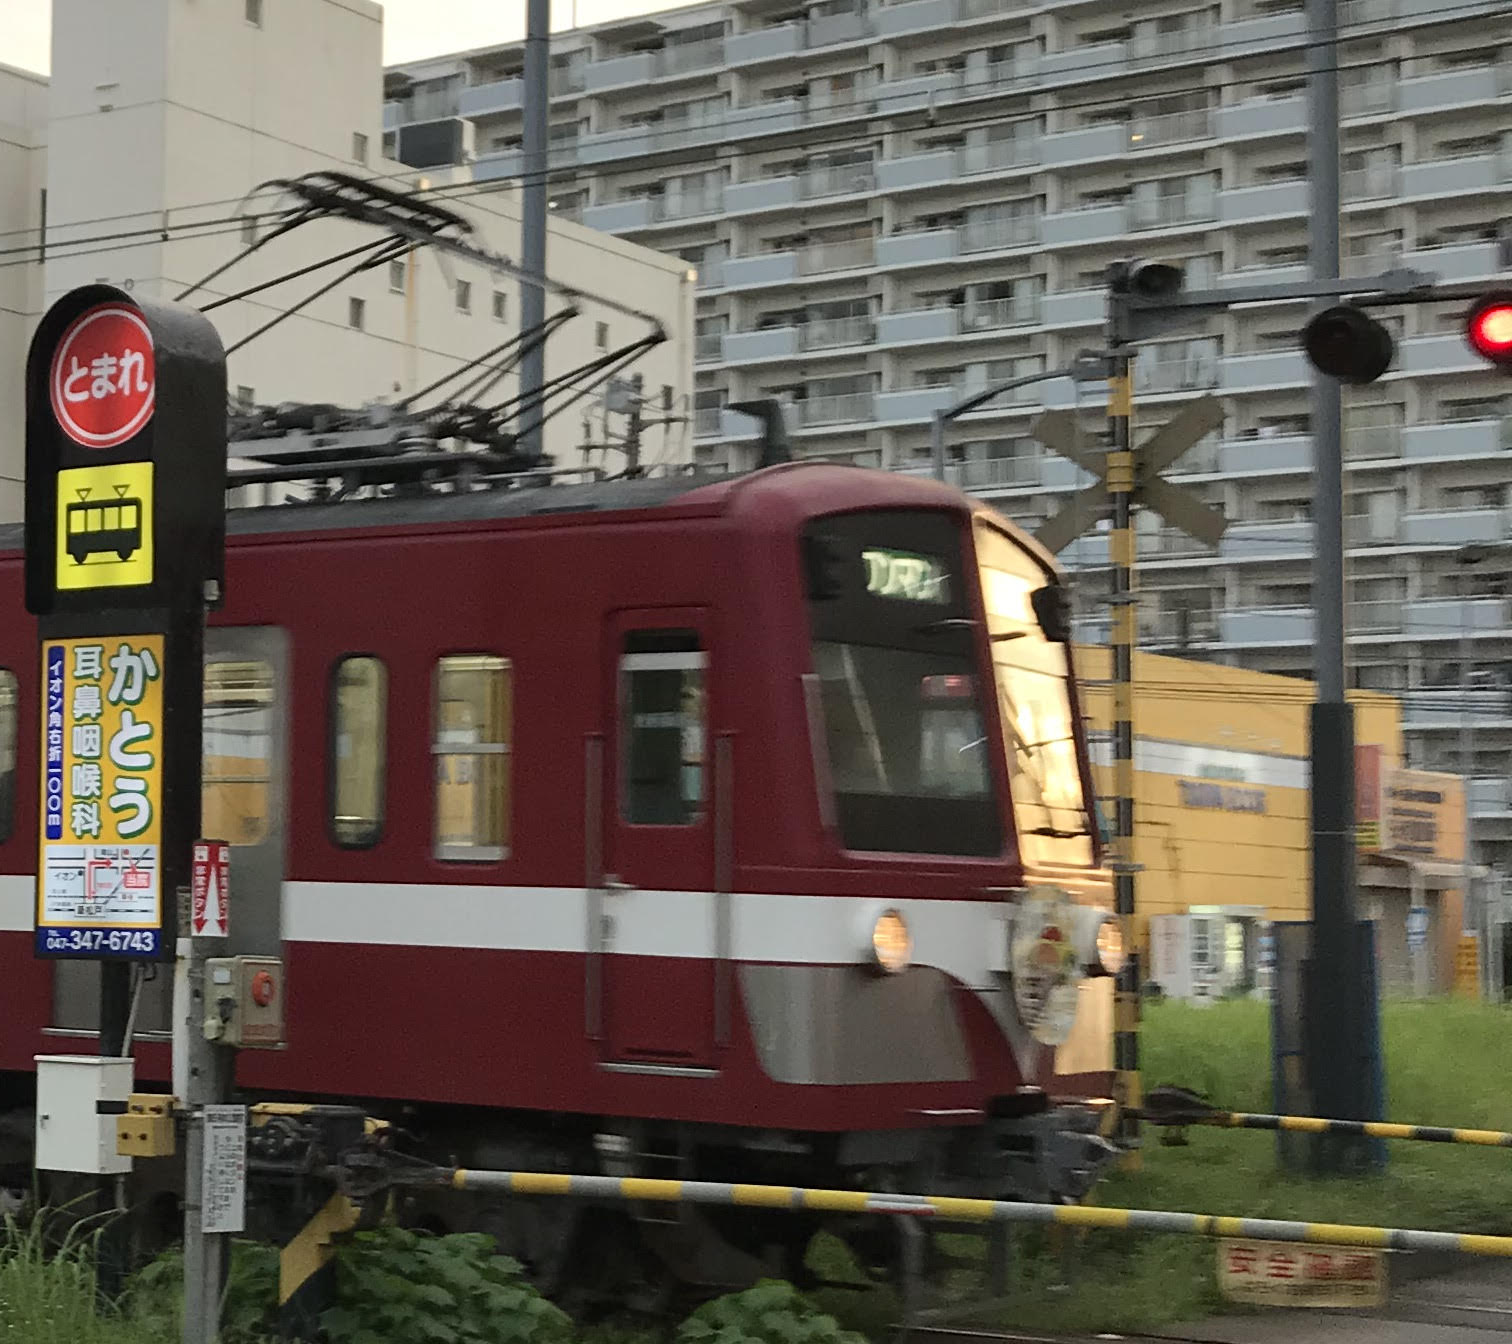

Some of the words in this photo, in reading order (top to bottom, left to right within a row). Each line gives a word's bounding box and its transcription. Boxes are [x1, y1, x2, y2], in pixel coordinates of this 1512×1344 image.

[64, 349, 148, 402] とまれ
[71, 644, 103, 839] 耳鼻咽喉科
[108, 644, 159, 838] かとう
[46, 930, 155, 952] 047-347-6743
